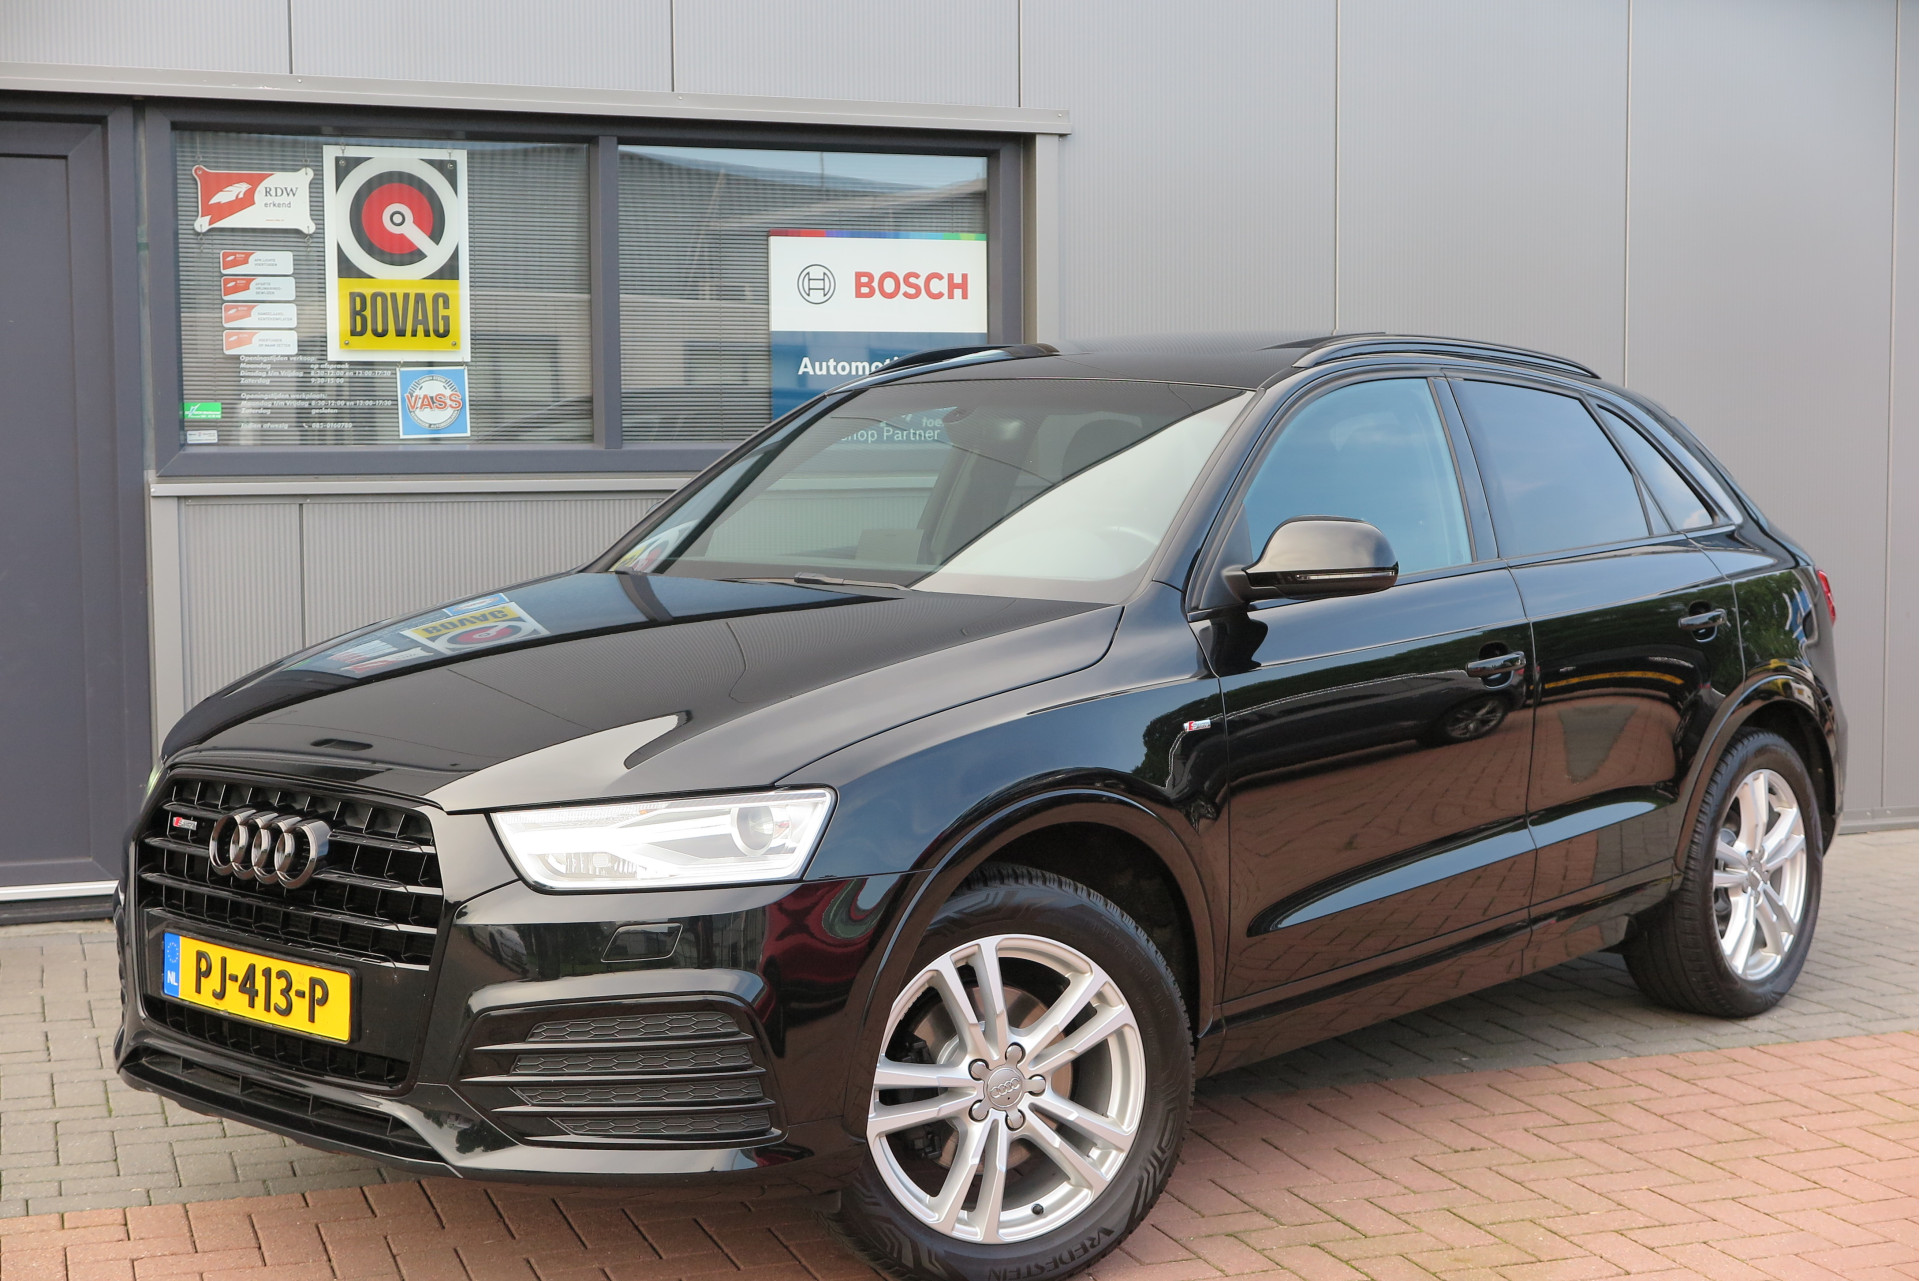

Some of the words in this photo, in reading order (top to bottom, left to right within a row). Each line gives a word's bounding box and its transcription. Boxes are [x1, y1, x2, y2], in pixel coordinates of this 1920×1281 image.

[264, 186, 298, 197] RDW
[854, 271, 968, 300] BOSCH
[349, 291, 450, 338] BOVAG
[798, 356, 899, 375] Automo
[405, 393, 463, 410] VASS
[841, 427, 878, 444] op
[884, 427, 940, 440] Partner
[167, 970, 178, 986] NL
[195, 950, 329, 1023] PJ-413-P
